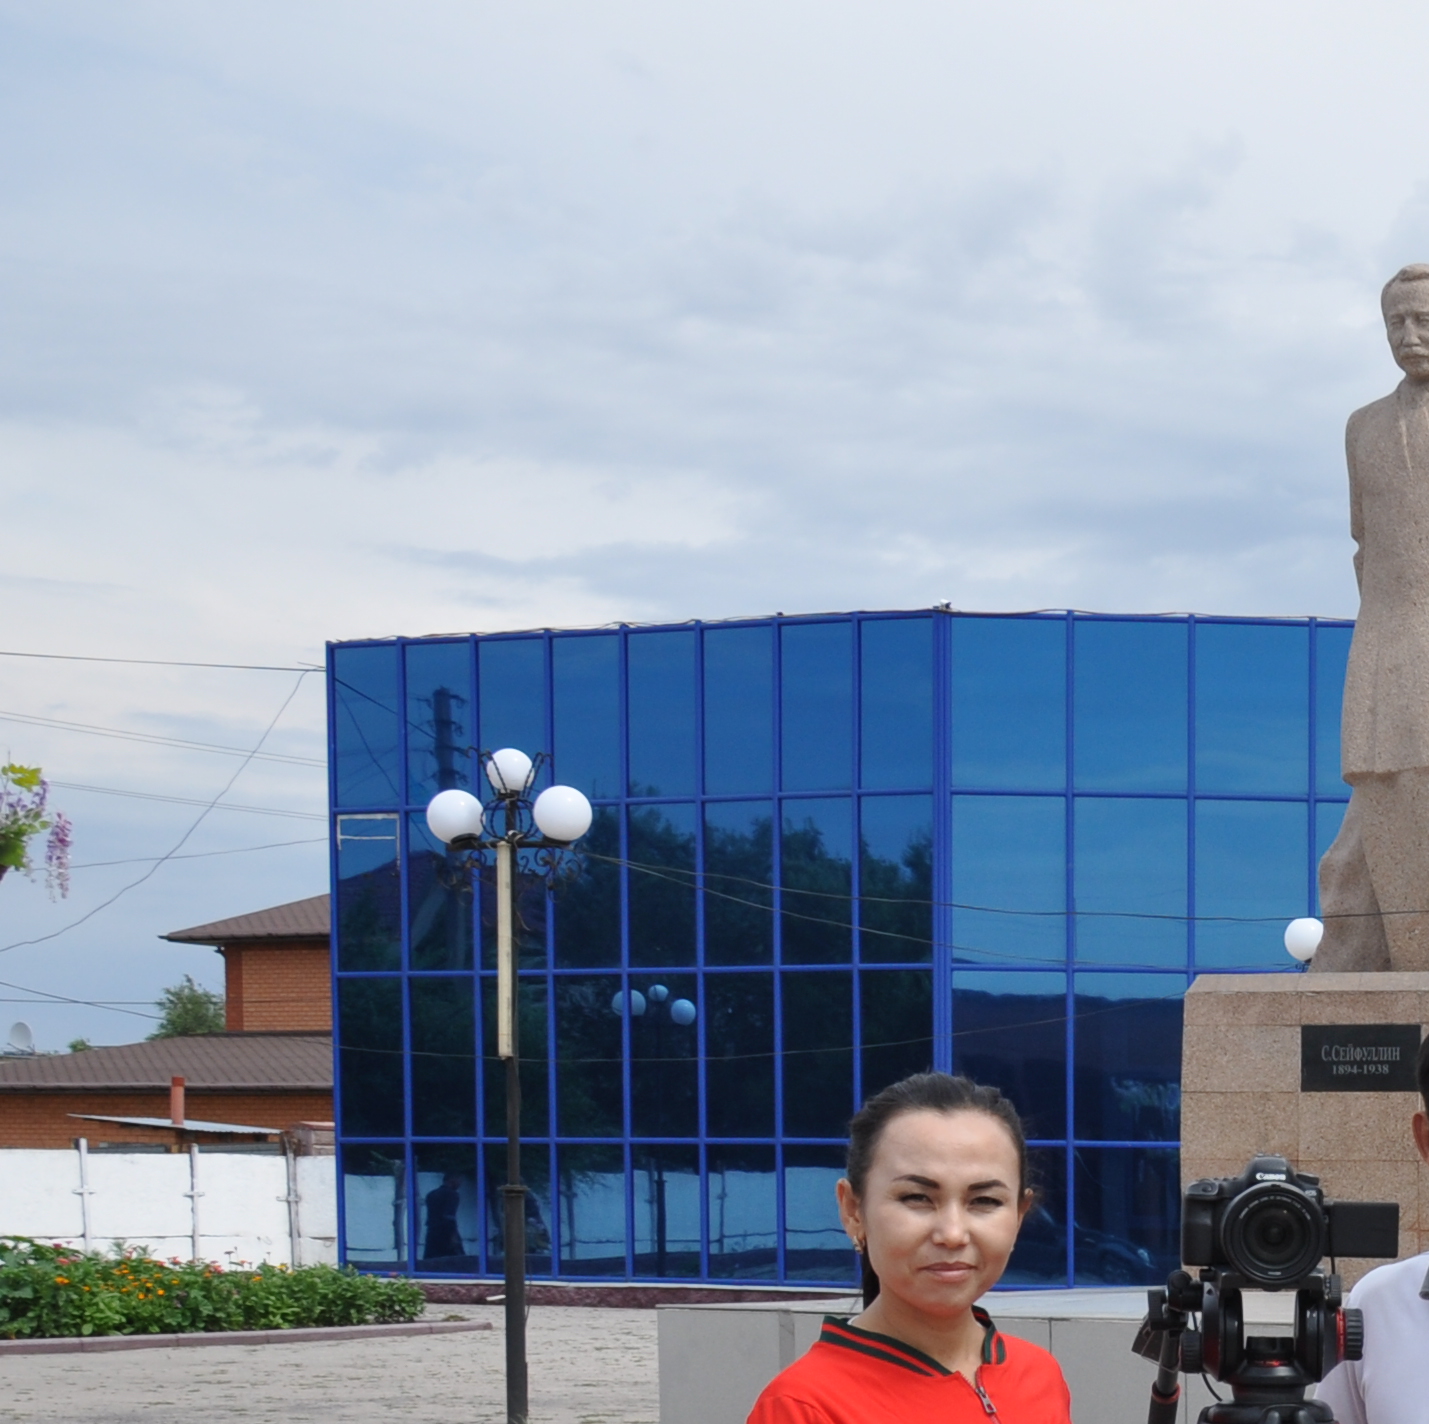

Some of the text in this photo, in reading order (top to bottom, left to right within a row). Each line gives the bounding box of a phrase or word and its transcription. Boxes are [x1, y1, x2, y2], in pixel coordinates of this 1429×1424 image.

[1321, 1044, 1401, 1062] С.СЕЙФУЛЛИН
[1332, 1063, 1390, 1075] 1894-1938
[1255, 1172, 1286, 1181] Canon
